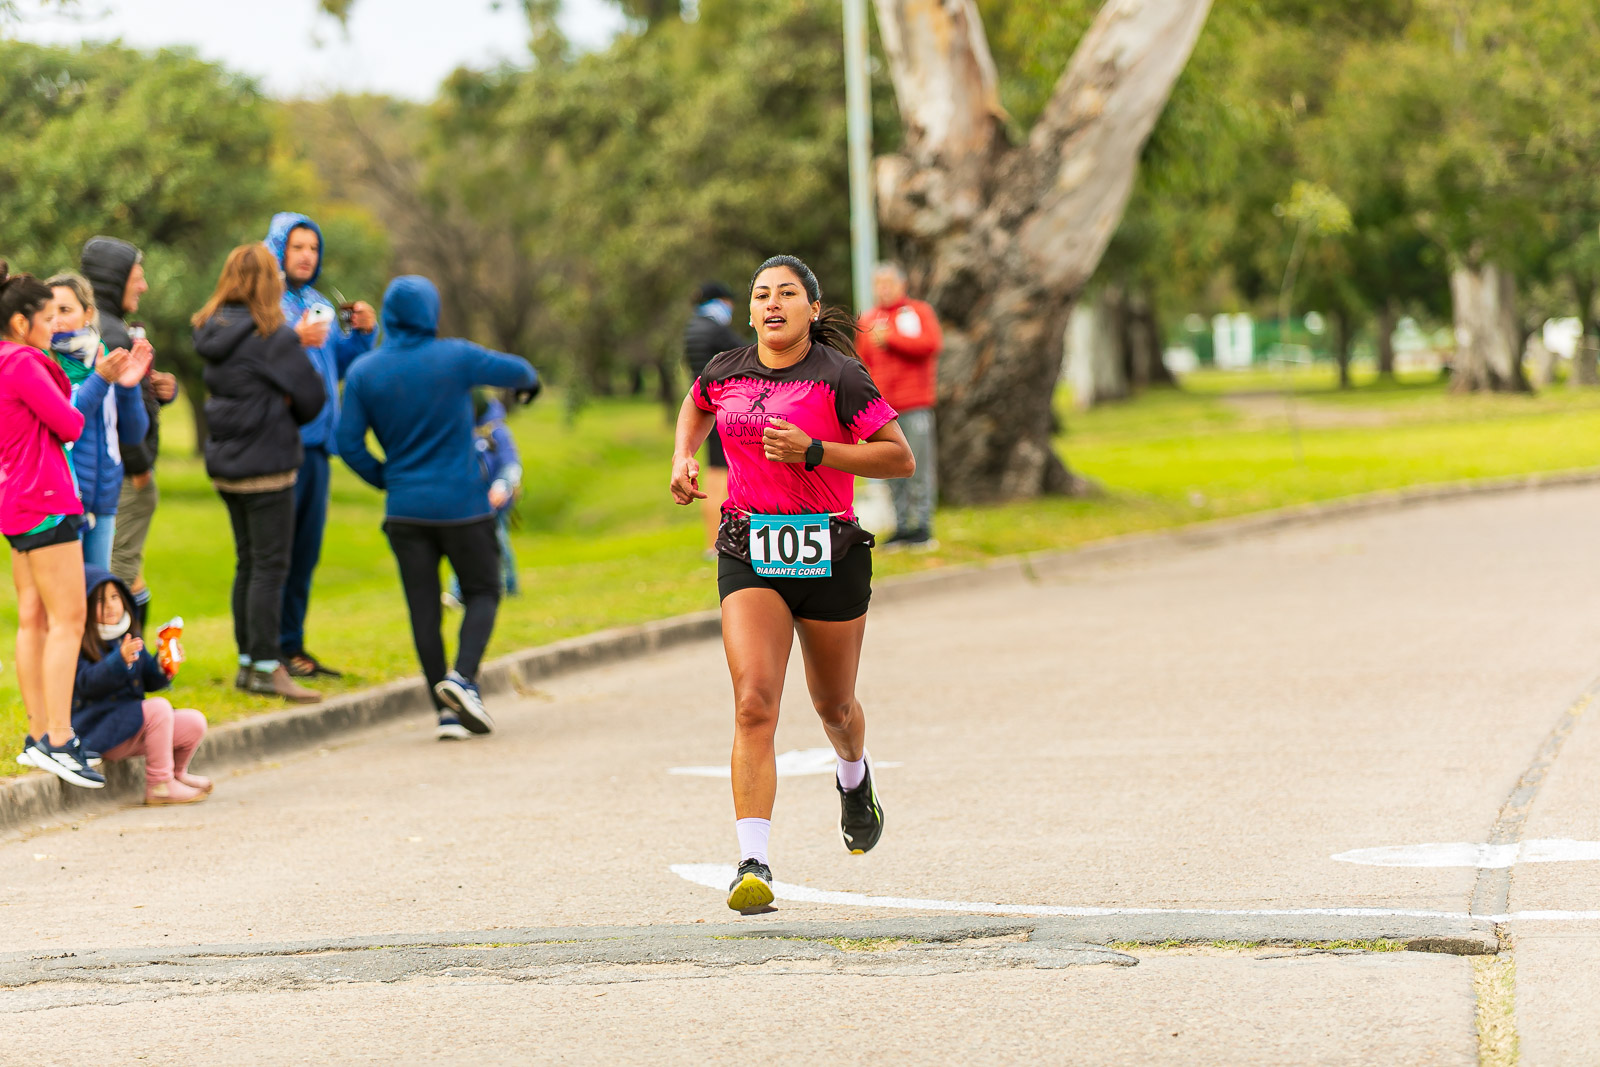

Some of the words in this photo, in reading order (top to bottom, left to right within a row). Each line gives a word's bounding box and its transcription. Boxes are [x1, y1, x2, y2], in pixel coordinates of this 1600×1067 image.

[755, 524, 823, 566] 105
[756, 567, 797, 576] DIAMANTE
[797, 567, 827, 576] CORRE
